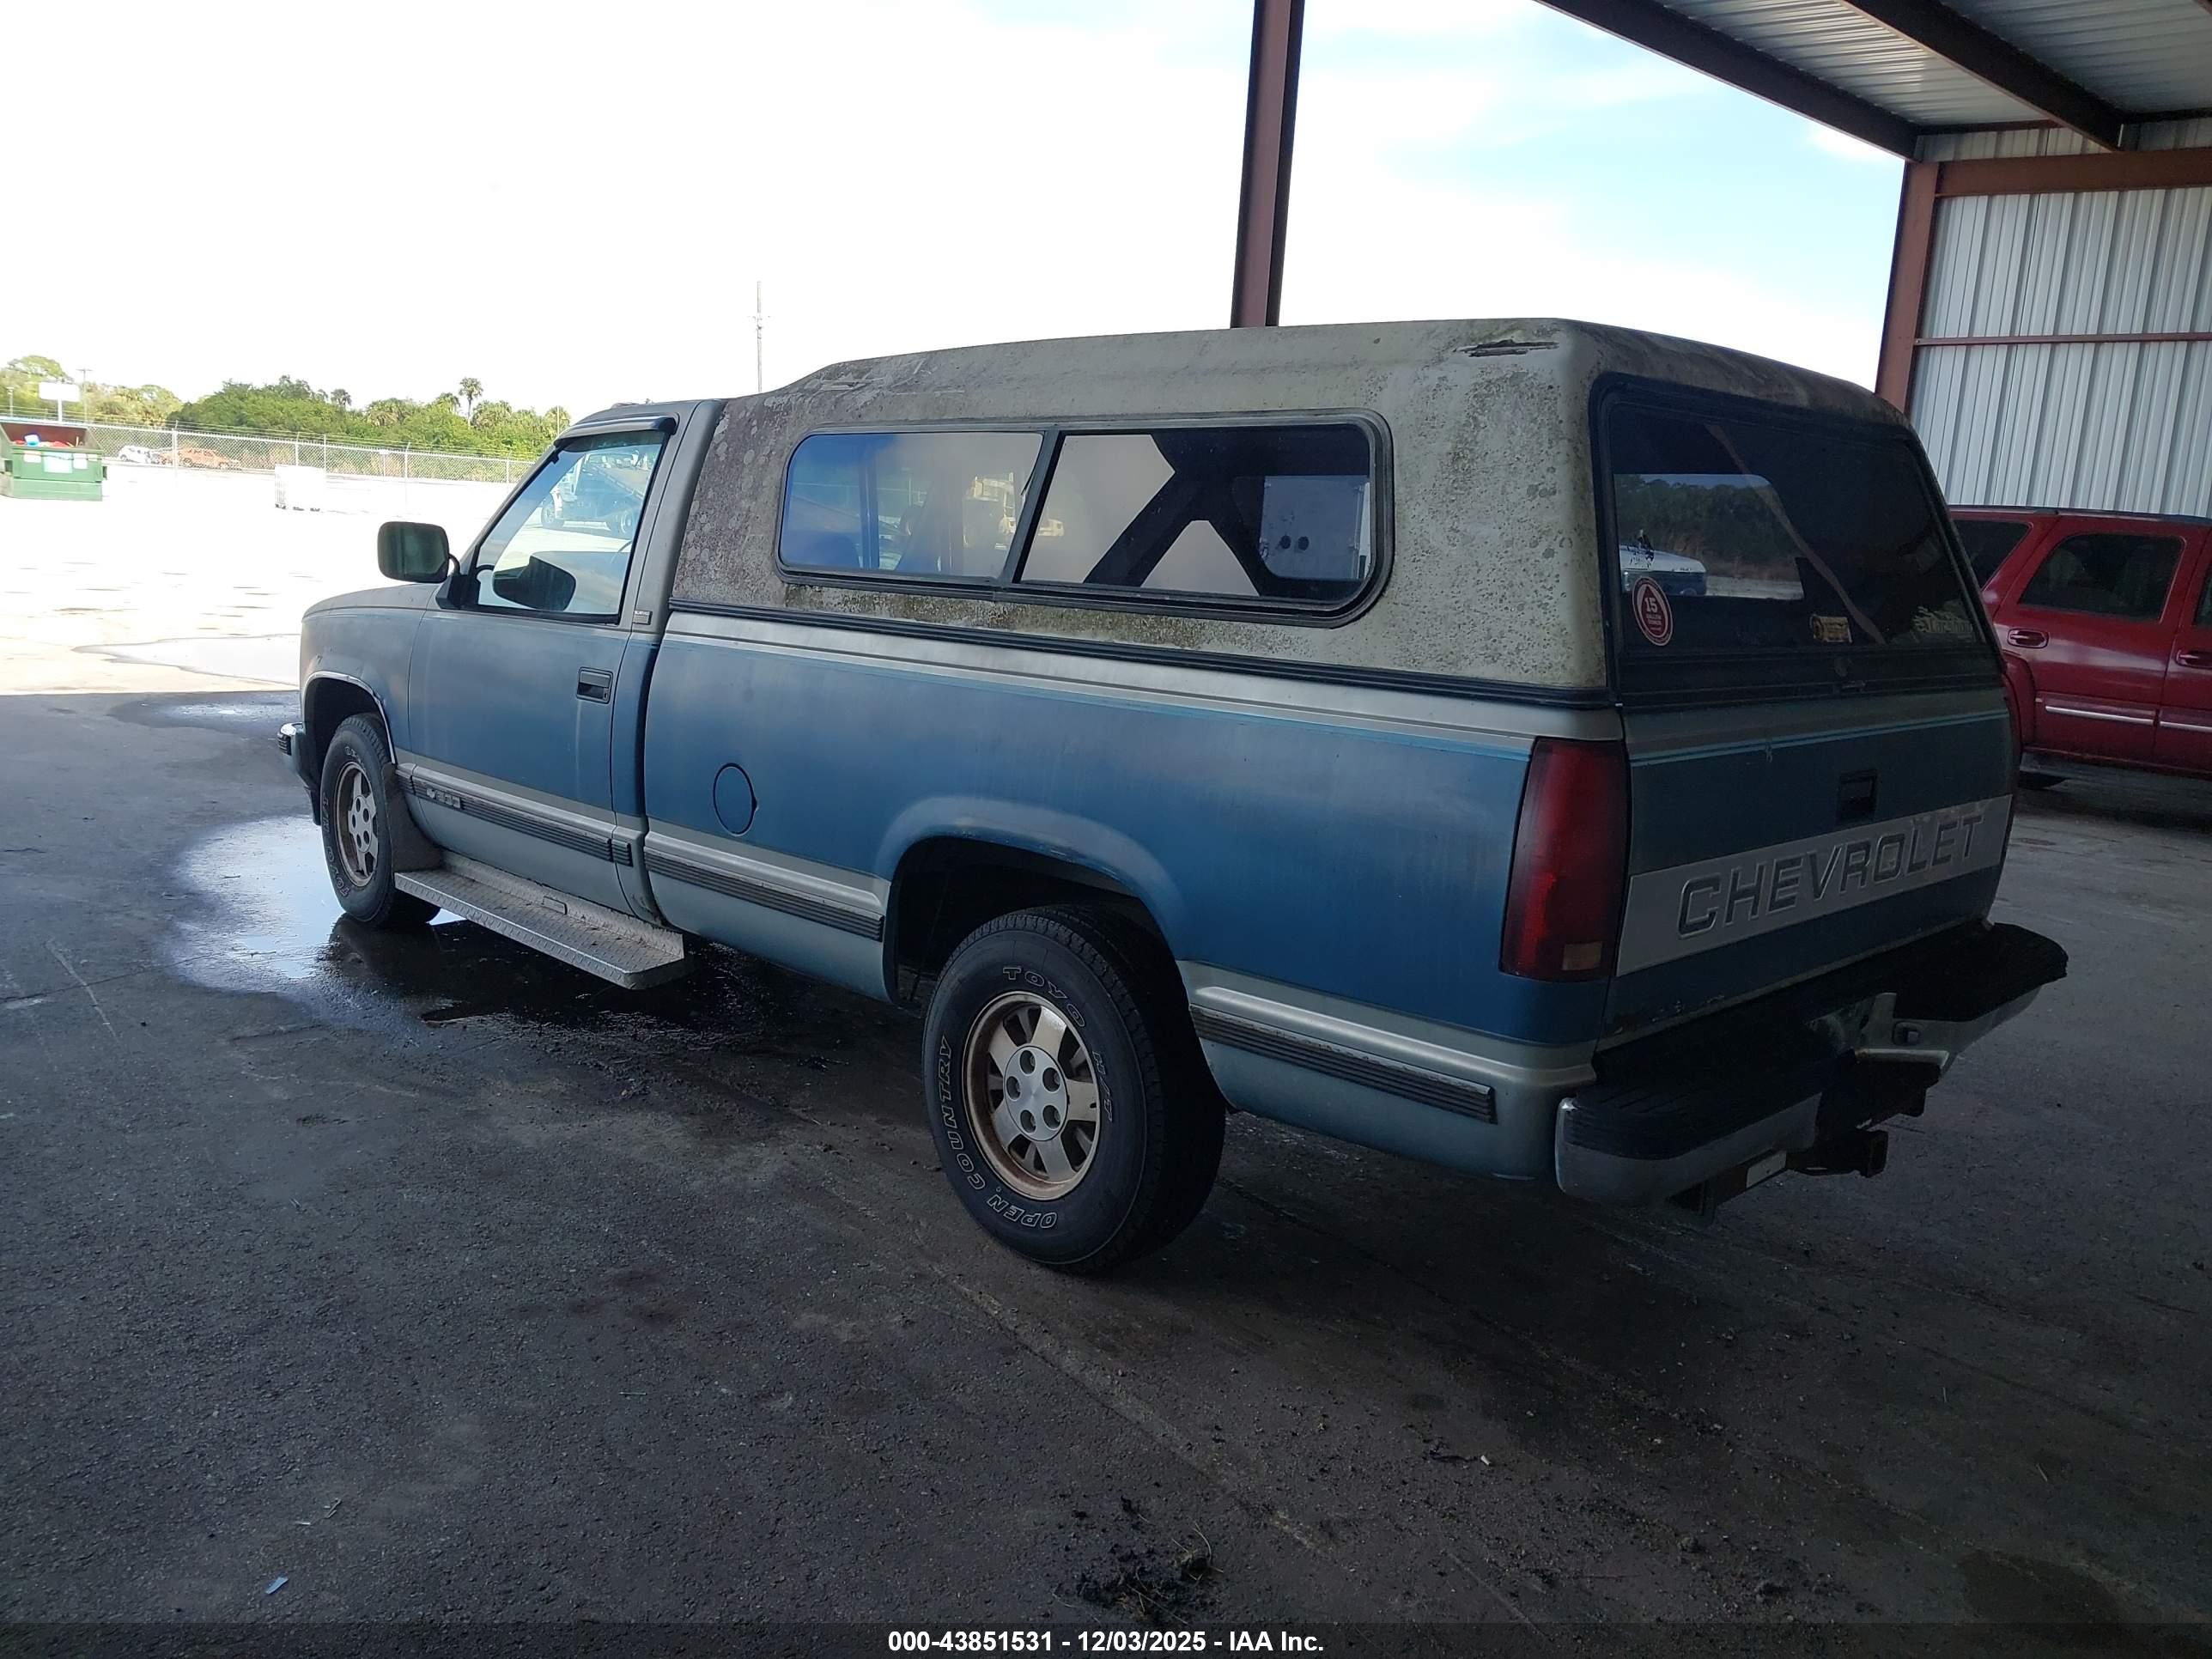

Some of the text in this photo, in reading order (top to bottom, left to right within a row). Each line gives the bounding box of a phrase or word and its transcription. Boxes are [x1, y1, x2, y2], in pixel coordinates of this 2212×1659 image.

[1644, 597, 1658, 613] 15
[1678, 814, 1984, 939] CHEVROLET
[1002, 966, 1085, 1028] TOYO
[938, 1035, 1058, 1229] OPEN COUNTRY
